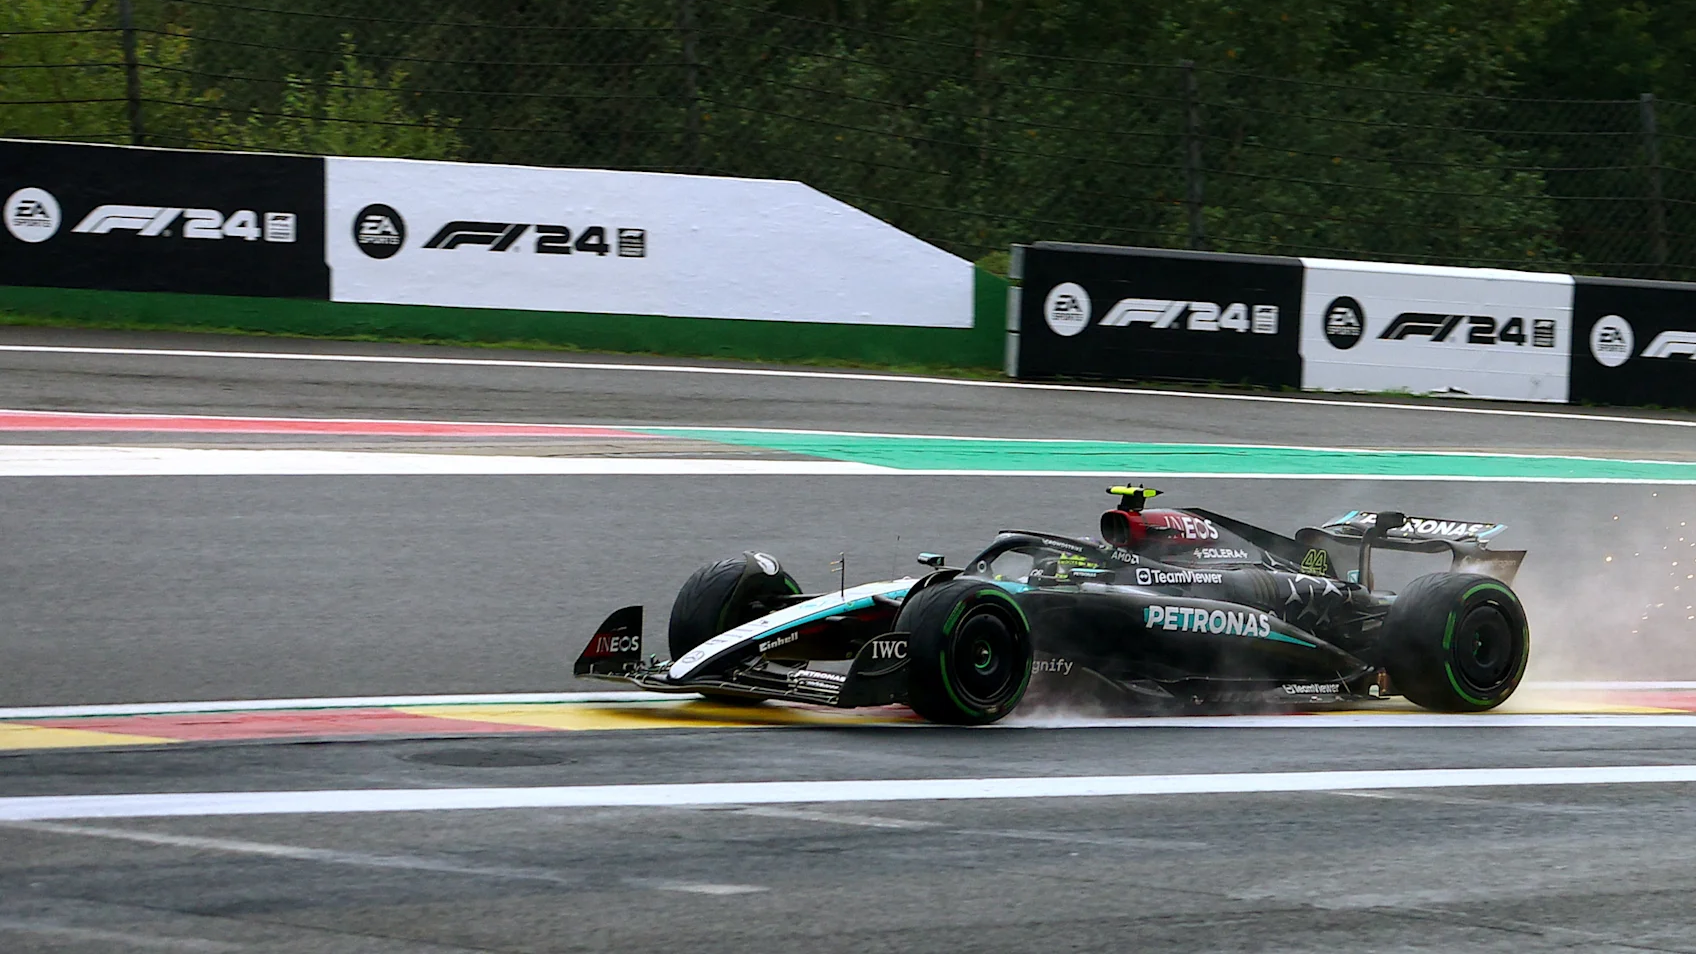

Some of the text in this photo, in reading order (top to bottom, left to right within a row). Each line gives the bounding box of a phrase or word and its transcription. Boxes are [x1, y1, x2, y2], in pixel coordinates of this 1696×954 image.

[14, 199, 50, 218] EA
[182, 208, 262, 241] 24
[359, 215, 400, 235] EA
[359, 234, 400, 244] SPORTS
[534, 224, 611, 256] 24
[1054, 294, 1083, 312] EA
[1186, 301, 1251, 333] 24
[1328, 307, 1360, 326] EA
[1468, 316, 1527, 346] 24
[1599, 327, 1626, 344] EA
[1164, 516, 1219, 540] INEOS
[1359, 512, 1483, 537] PRONAS
[1110, 550, 1131, 563] AMD
[1202, 548, 1241, 559] SOLERA
[1301, 548, 1328, 576] 44
[1151, 569, 1223, 584] TeamViewer
[1145, 605, 1271, 637] PETRONAS
[596, 635, 639, 653] INEOS
[759, 631, 799, 653] Einhell
[872, 640, 908, 659] IWC
